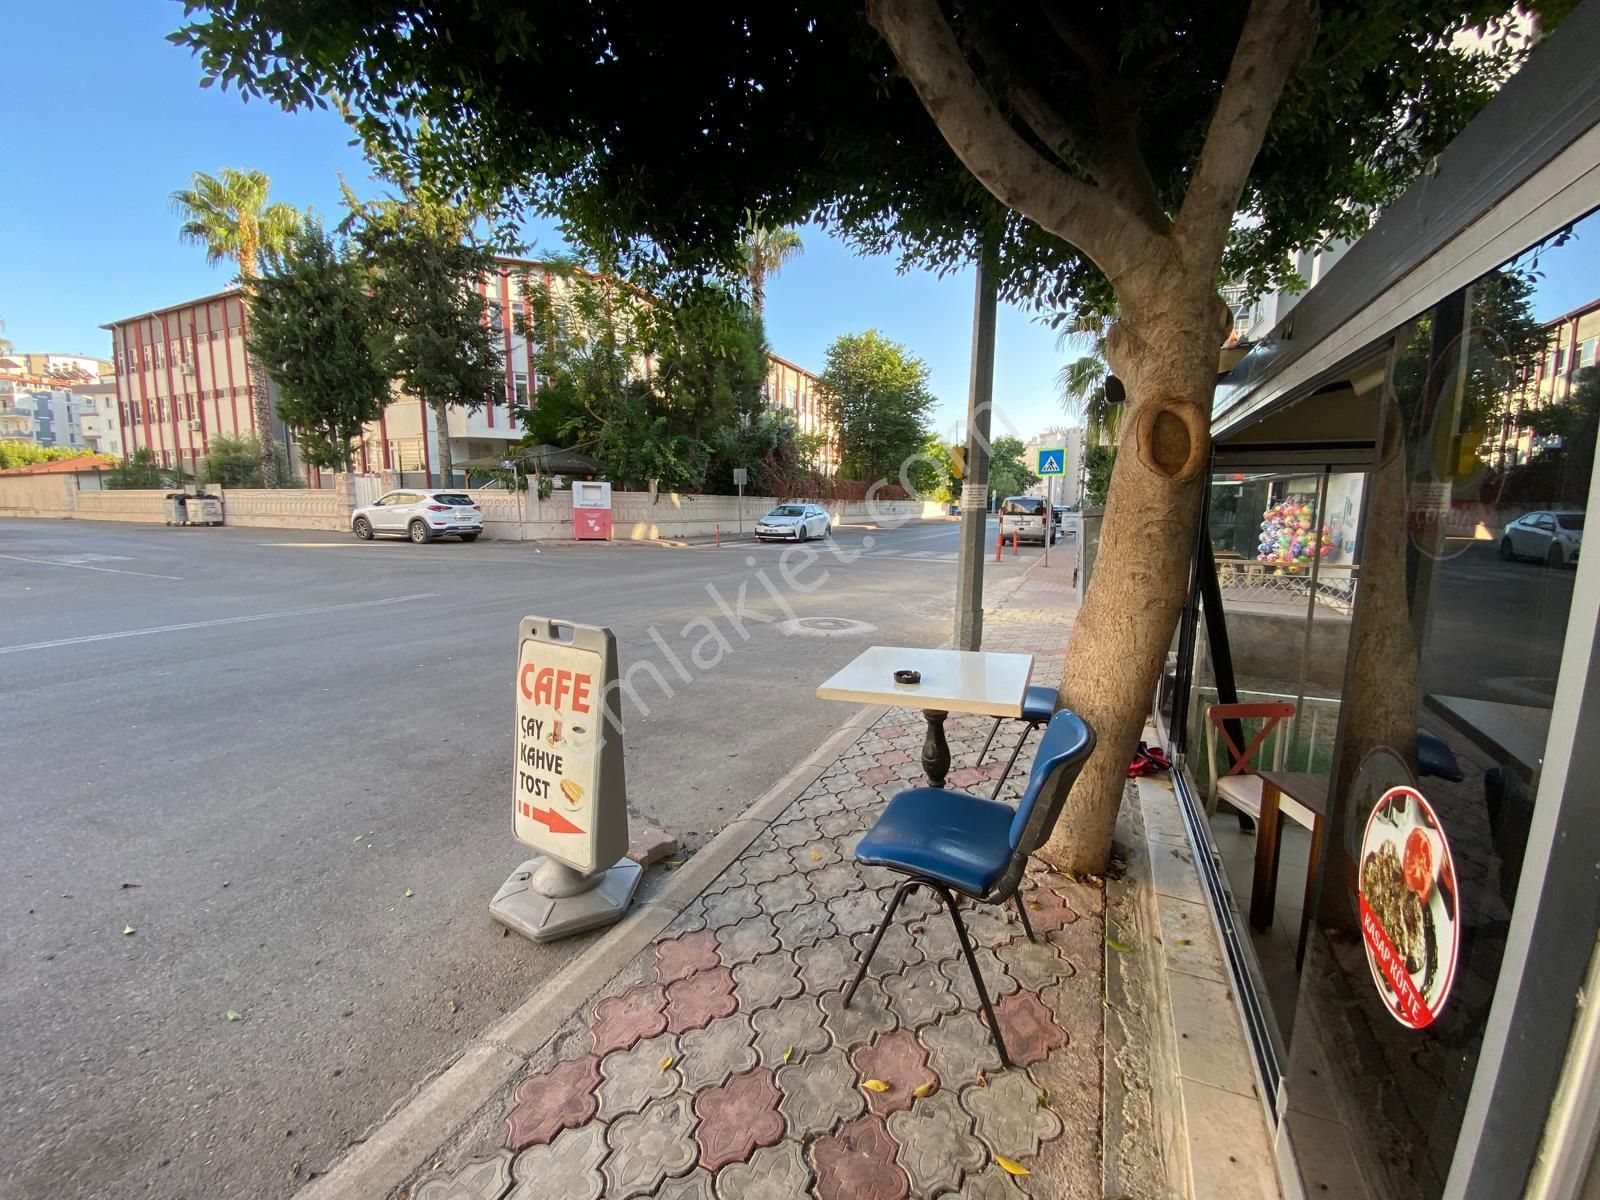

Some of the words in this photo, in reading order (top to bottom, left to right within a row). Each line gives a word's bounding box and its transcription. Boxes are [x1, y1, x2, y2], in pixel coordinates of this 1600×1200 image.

[521, 664, 591, 713] CAFE
[521, 715, 544, 739] ÇAY
[520, 742, 563, 775] KAHVE
[519, 771, 550, 799] TOST
[1364, 912, 1390, 960] KASAP
[1390, 961, 1421, 1021] KÖFTE
